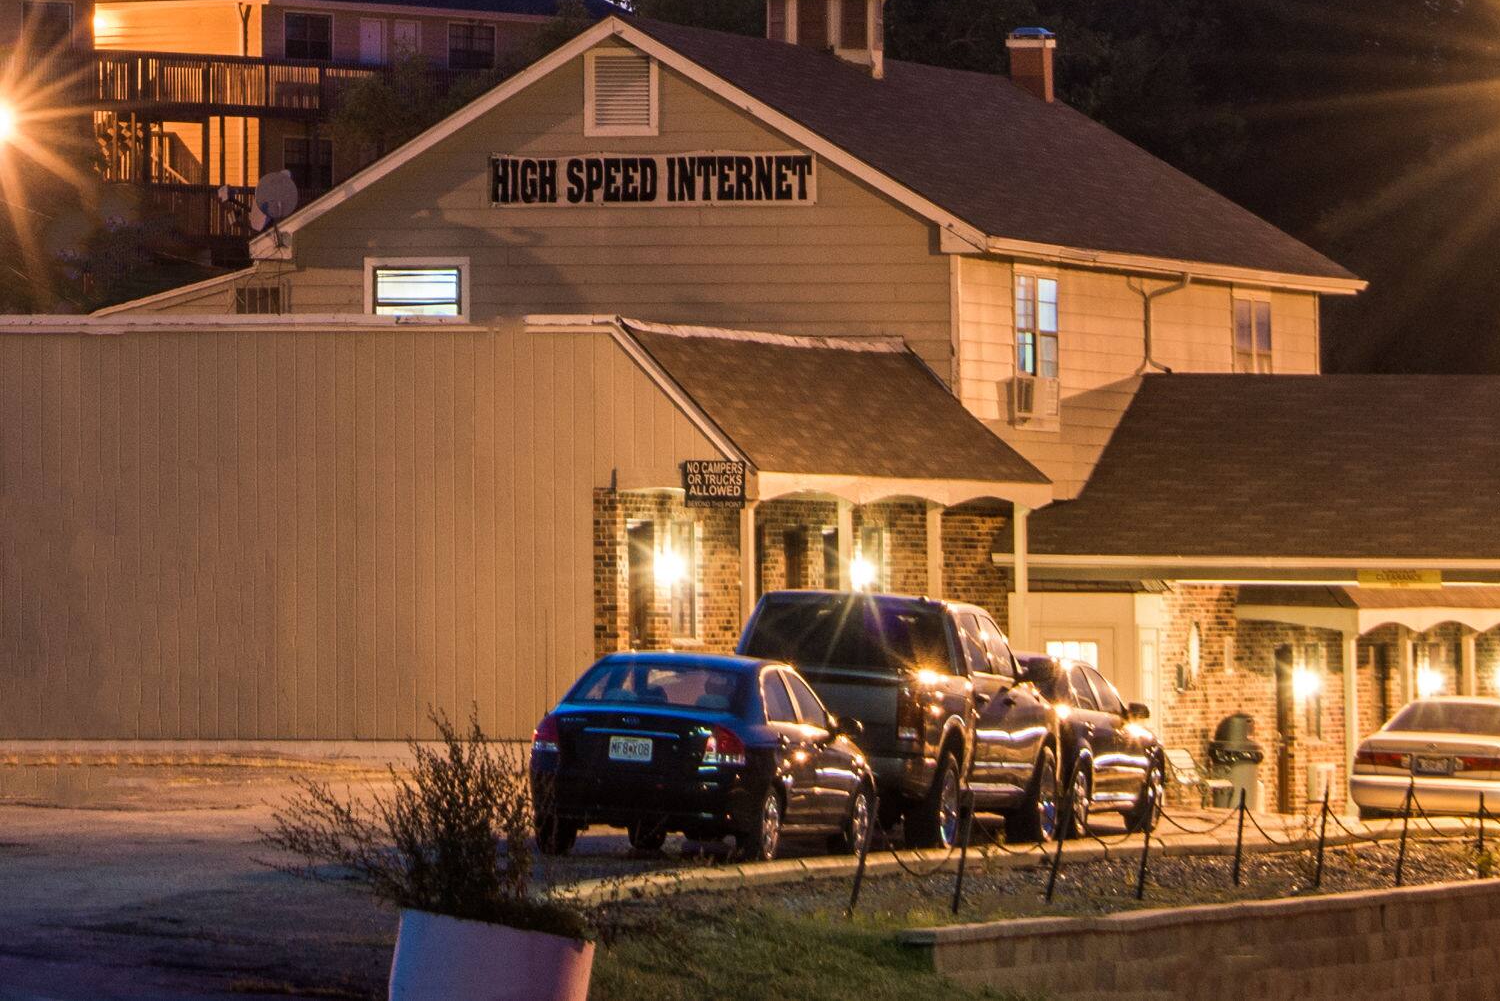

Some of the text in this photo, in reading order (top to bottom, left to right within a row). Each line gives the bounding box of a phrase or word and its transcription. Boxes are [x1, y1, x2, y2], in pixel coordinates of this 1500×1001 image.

[492, 155, 812, 203] HIGH SPEED INTERNET
[687, 462, 743, 474] NO CAMPERS
[688, 474, 743, 485] OR TRUCKS
[689, 485, 740, 496] ALLOWED
